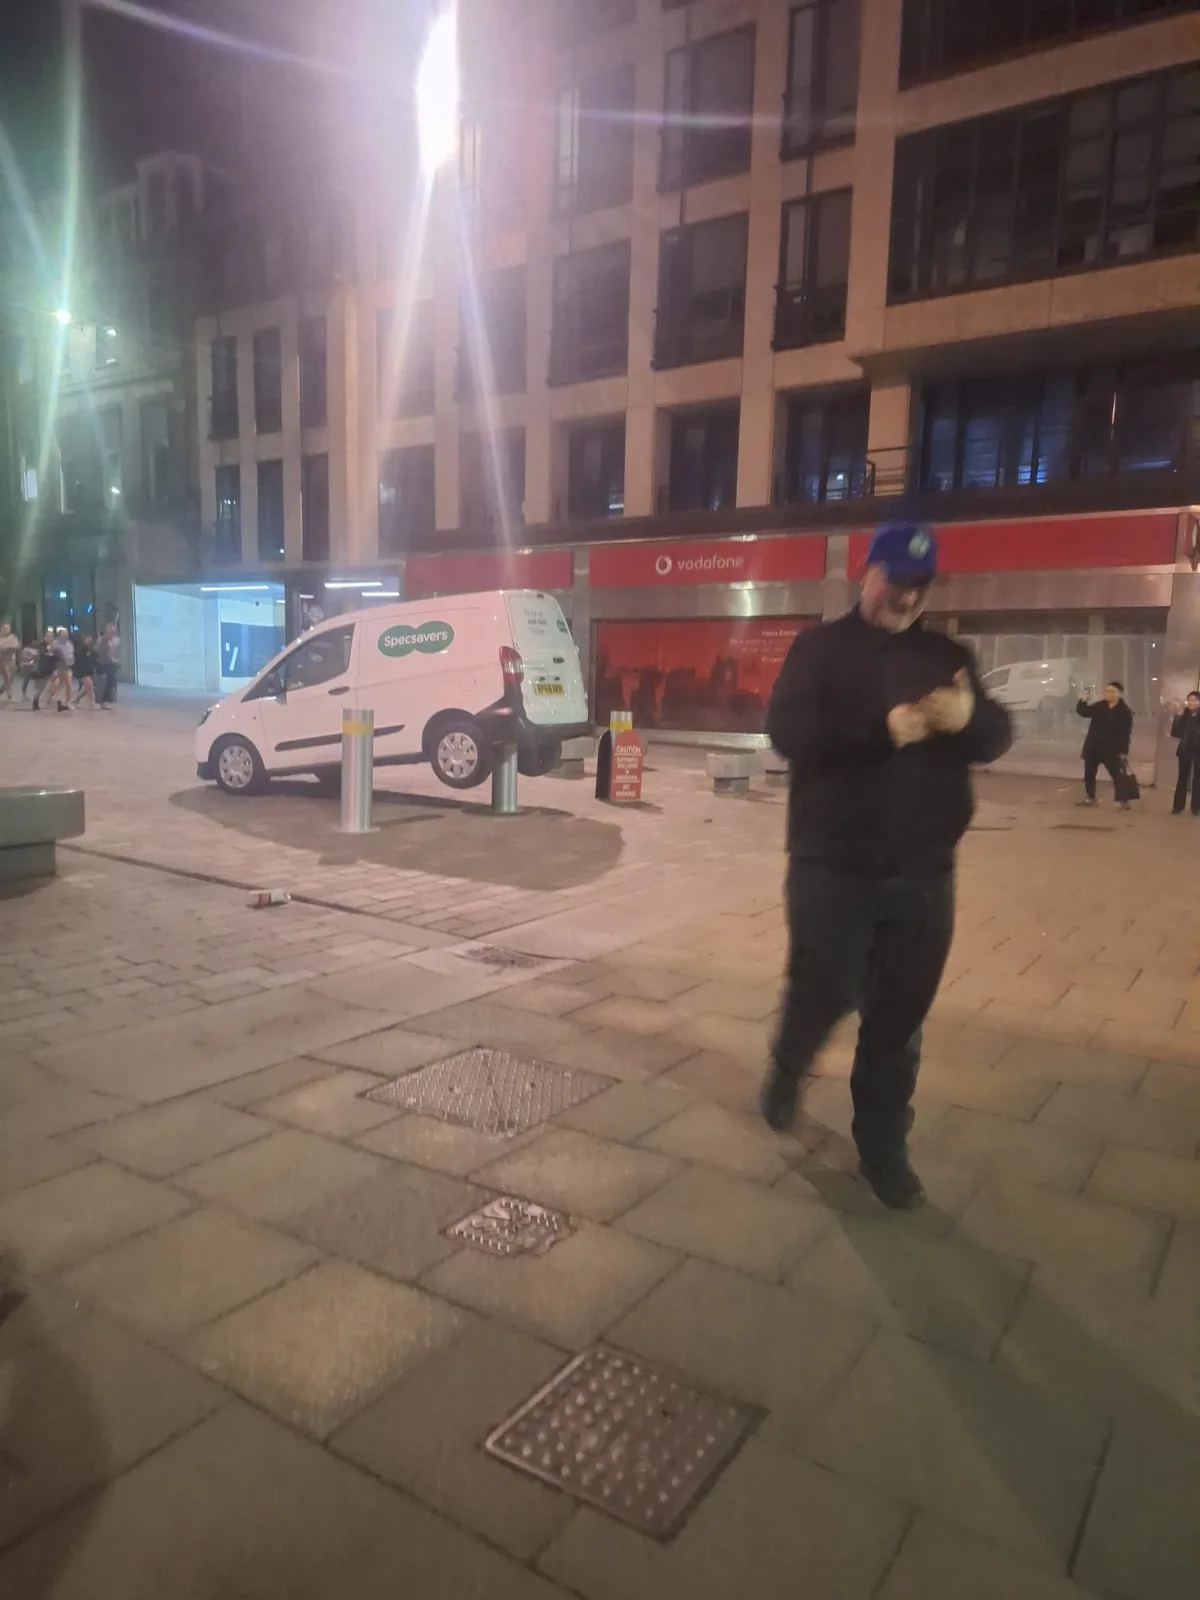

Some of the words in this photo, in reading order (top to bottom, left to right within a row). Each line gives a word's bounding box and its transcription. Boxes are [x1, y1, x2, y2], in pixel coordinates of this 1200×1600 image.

[677, 555, 743, 570] vodafone
[383, 630, 448, 649] Specsavers
[616, 745, 641, 754] CAUTION
